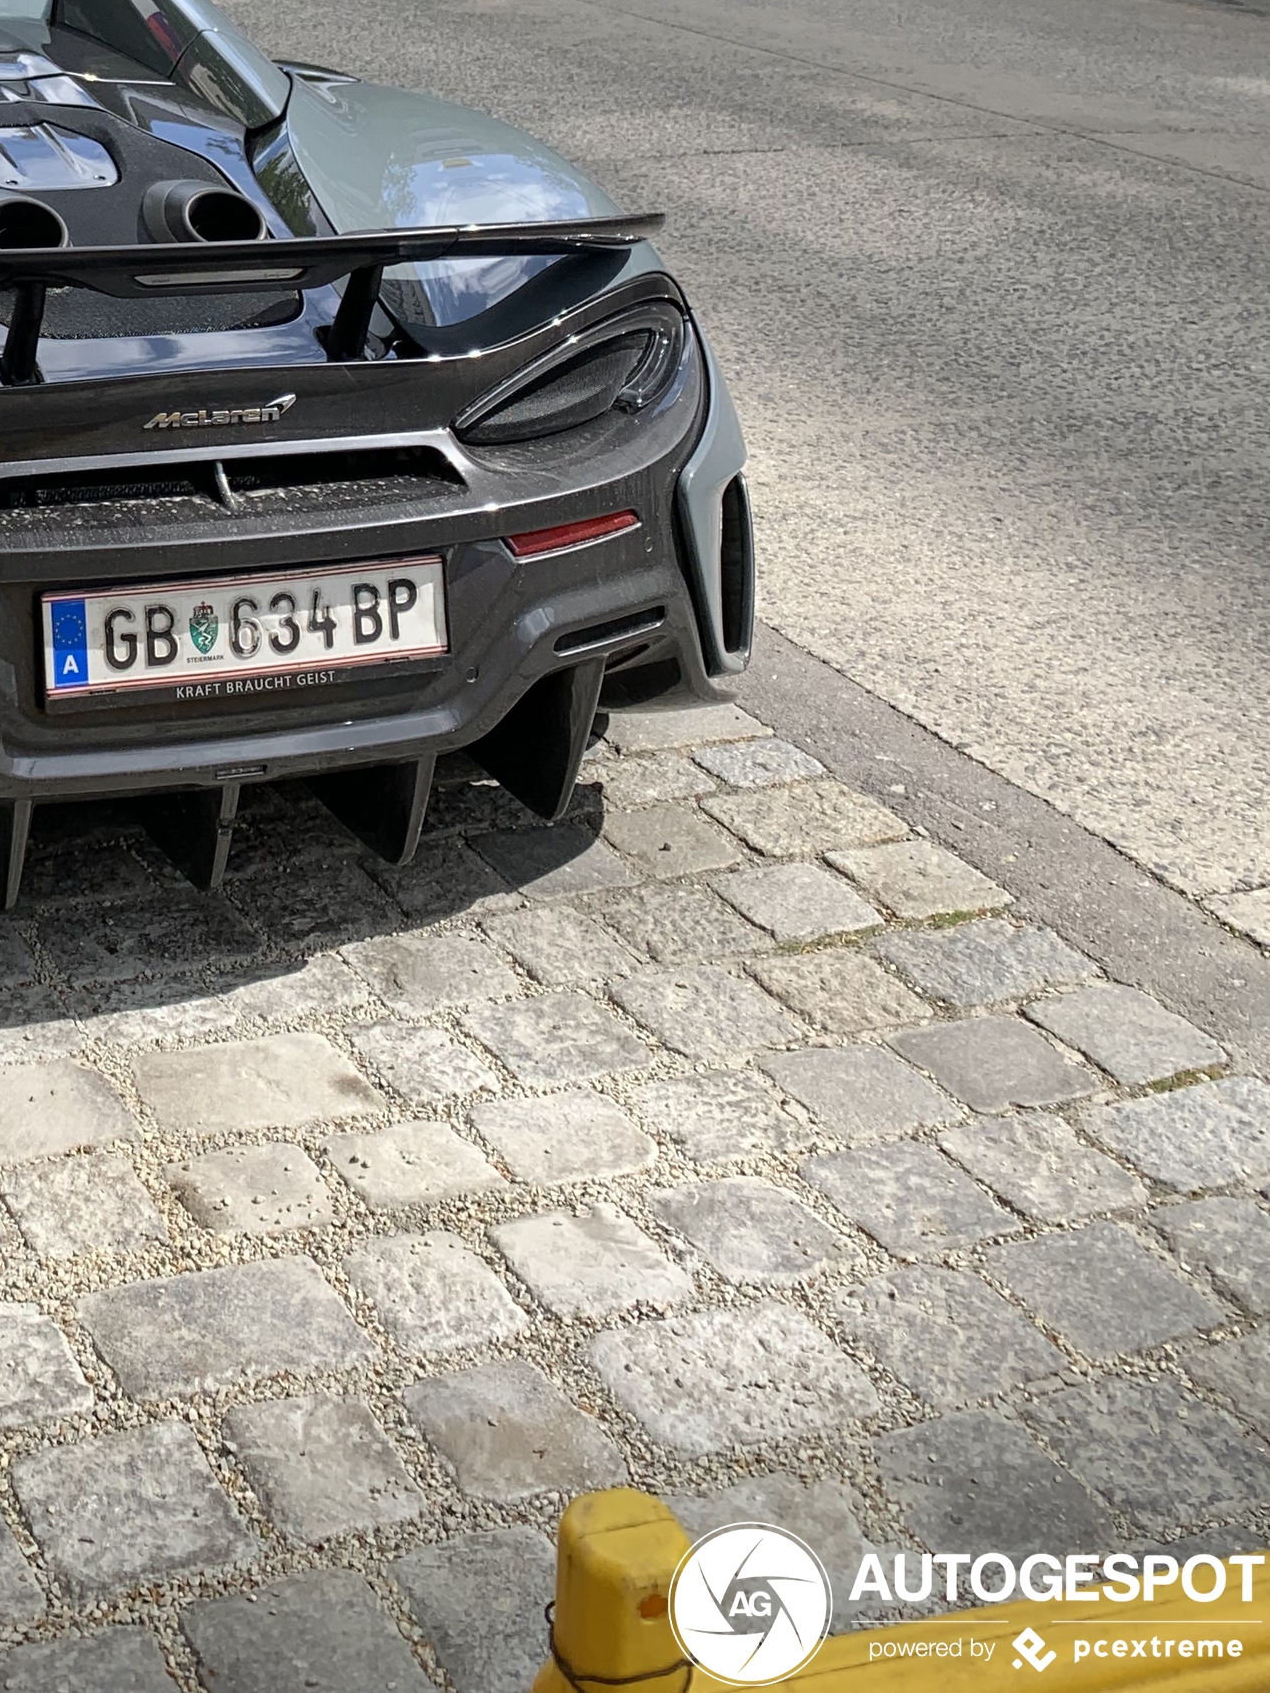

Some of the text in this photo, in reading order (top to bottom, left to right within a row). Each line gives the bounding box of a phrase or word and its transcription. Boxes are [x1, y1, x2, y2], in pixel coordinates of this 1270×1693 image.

[142, 407, 280, 430] McLaren
[104, 577, 418, 671] GB 634 BP
[62, 654, 79, 675] A
[186, 654, 225, 664] STEIERMARK
[176, 670, 336, 699] KRAFT BRAUCHT GEIST
